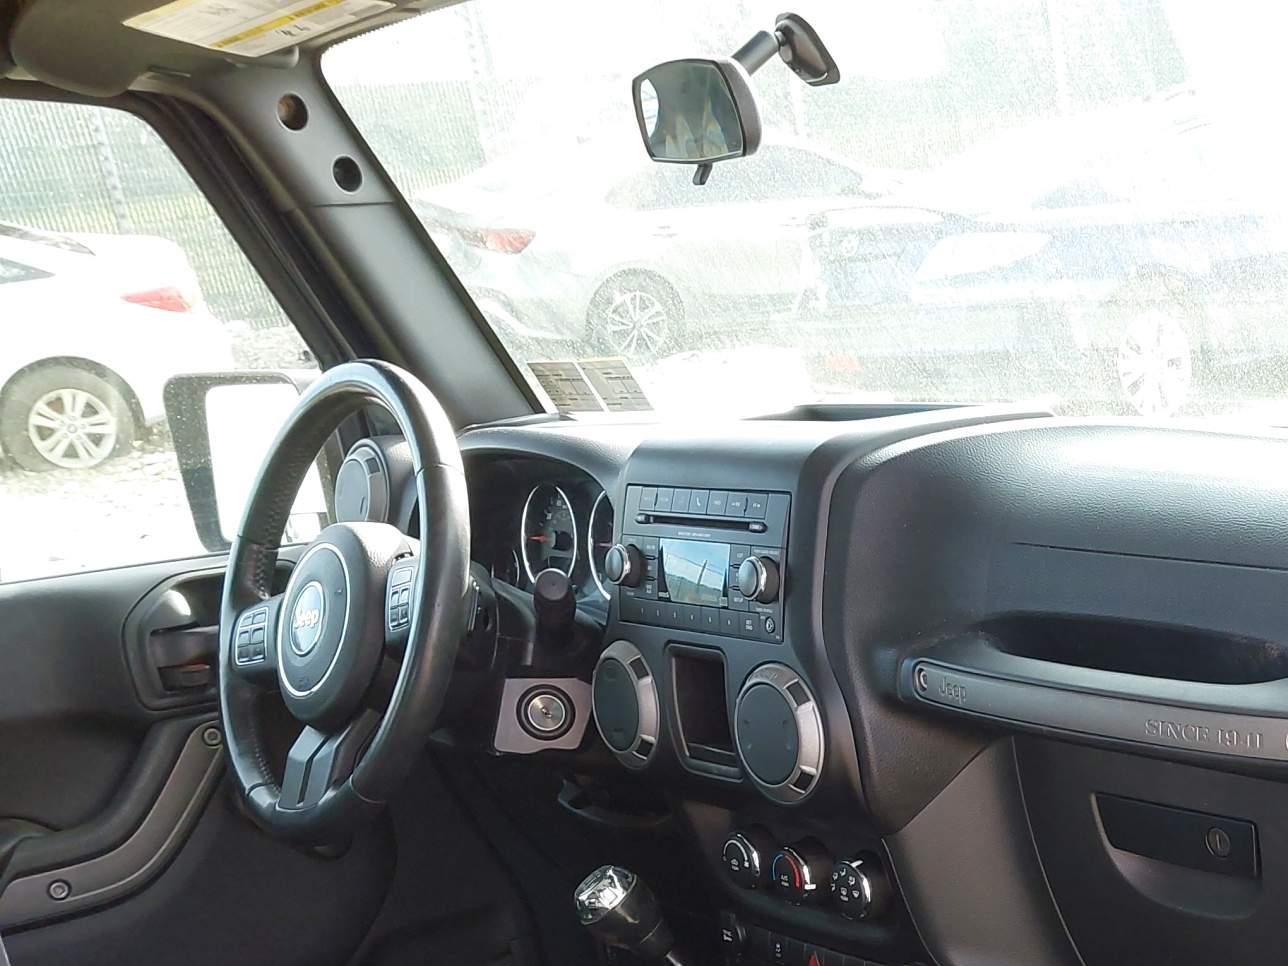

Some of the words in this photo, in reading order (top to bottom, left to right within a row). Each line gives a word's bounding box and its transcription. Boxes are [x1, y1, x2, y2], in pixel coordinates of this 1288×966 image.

[293, 603, 321, 629] Jeep
[938, 675, 967, 704] Jeep
[1145, 719, 1209, 741] SINCE
